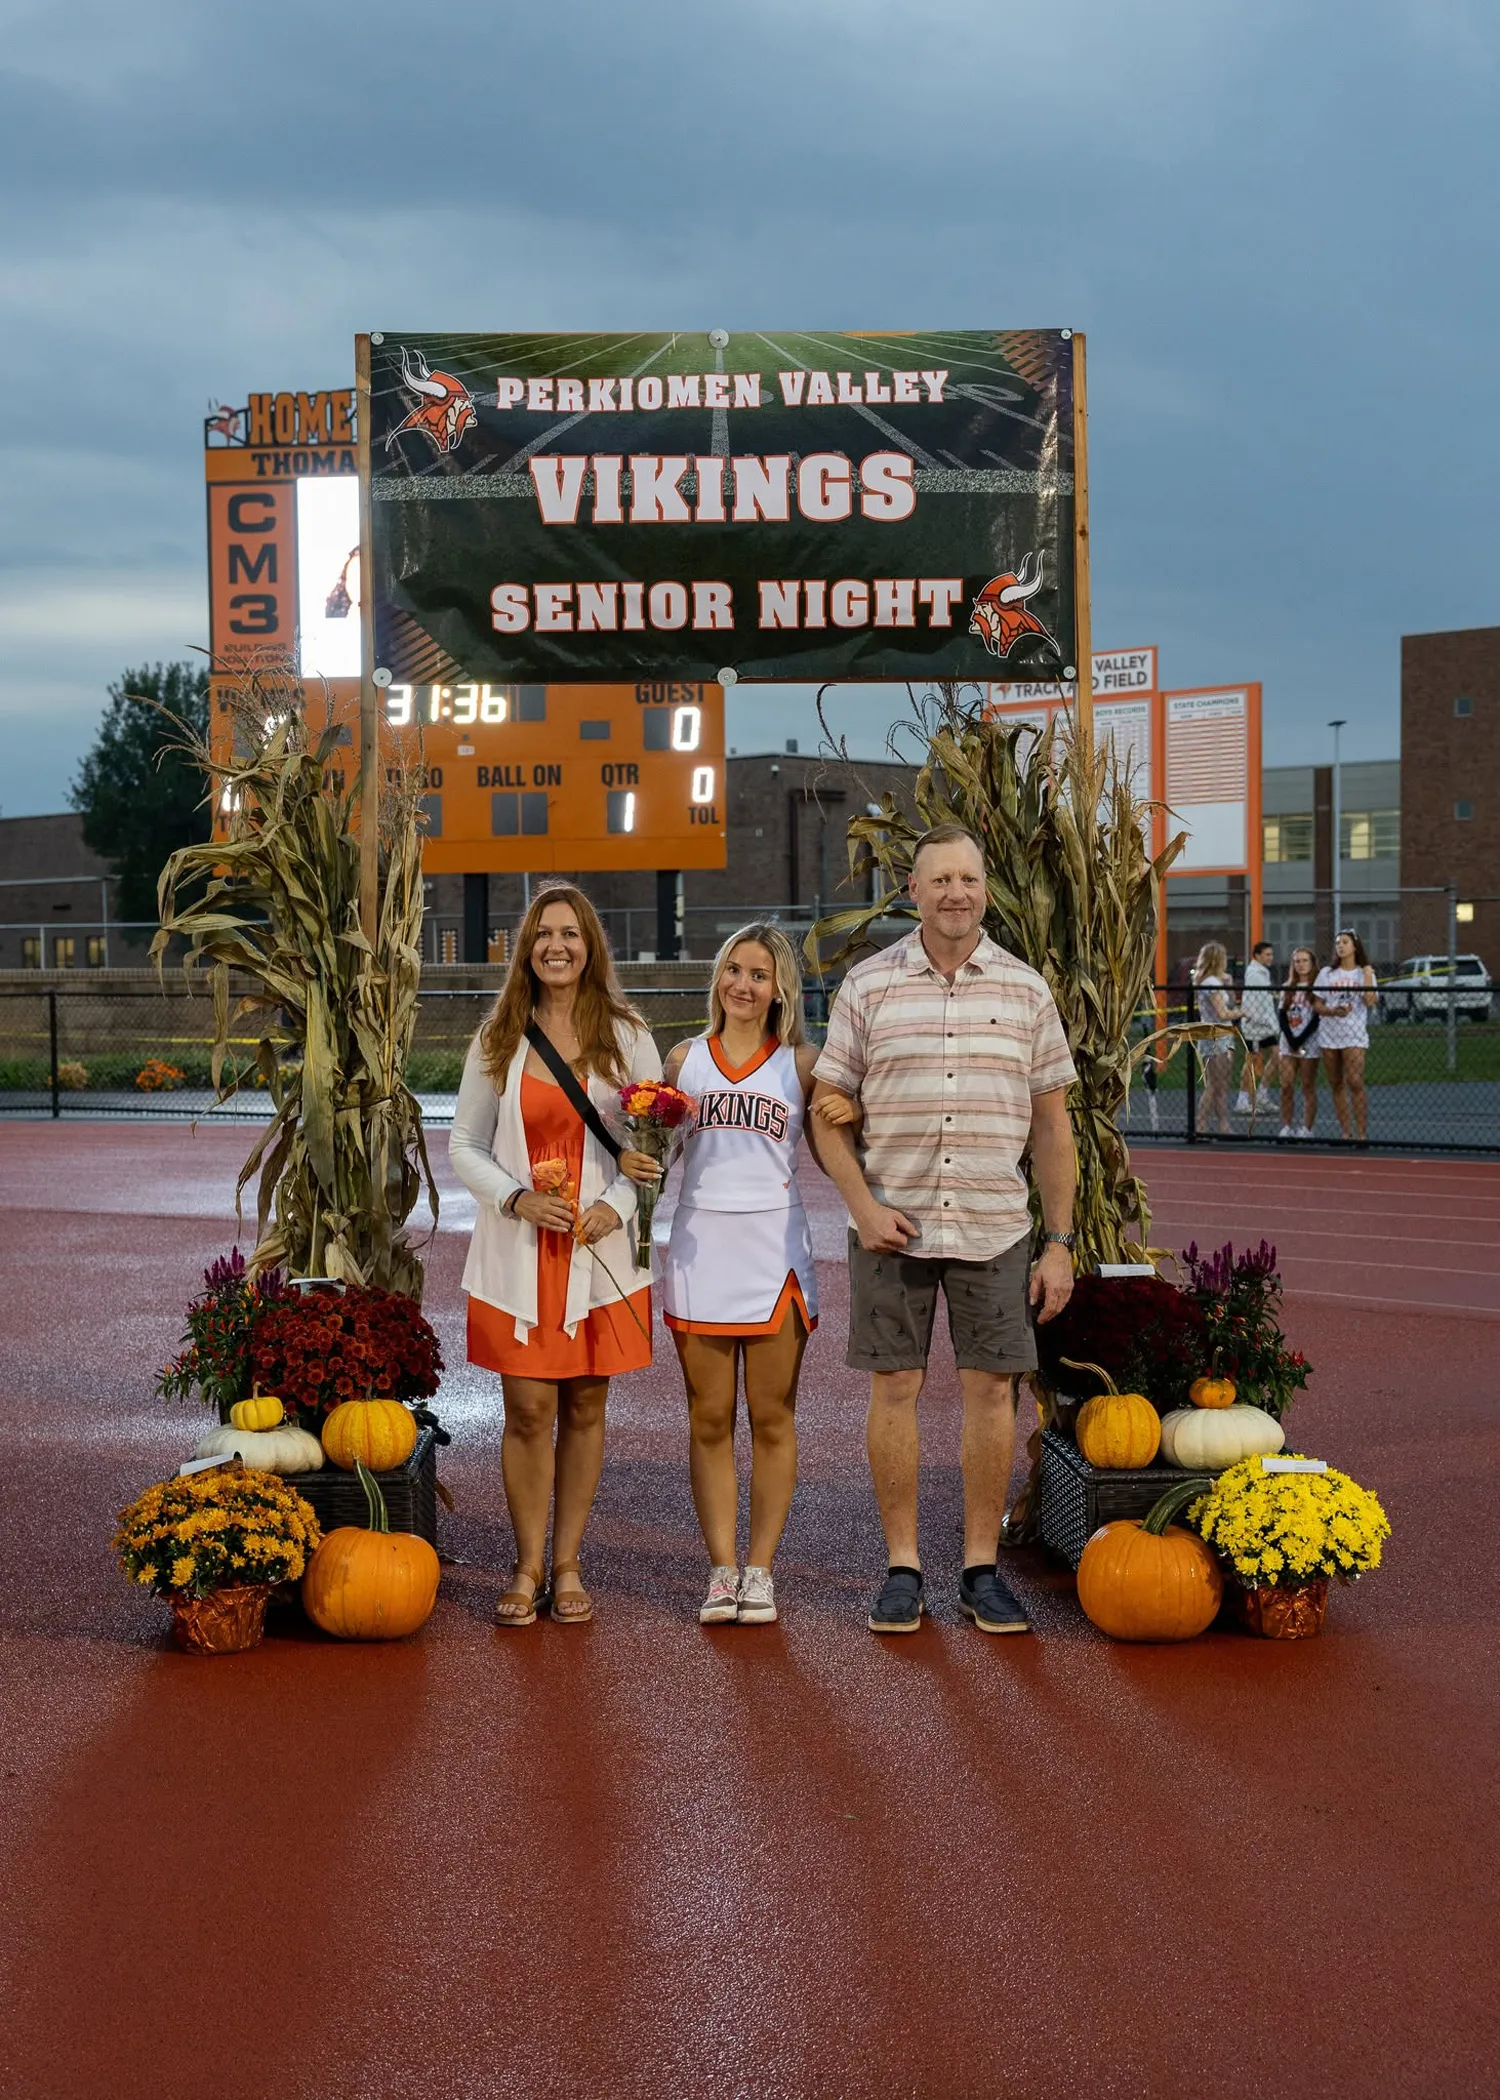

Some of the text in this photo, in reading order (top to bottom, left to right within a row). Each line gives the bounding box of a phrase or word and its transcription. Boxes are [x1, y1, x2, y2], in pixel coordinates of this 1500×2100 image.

[496, 369, 949, 412] PERKIOMEN VALLEY
[248, 391, 353, 445] HOME
[528, 451, 917, 525] VIKINGS
[490, 577, 964, 633] SENIOR NIGHT
[1095, 654, 1147, 673] VALLEY
[1104, 671, 1147, 689] FIELD
[635, 684, 704, 704] GUEST
[672, 706, 701, 751] 0
[477, 764, 562, 788] BALL ON
[601, 763, 639, 787] QTR
[688, 807, 719, 825] TOL
[687, 1090, 788, 1142] IKINGS
